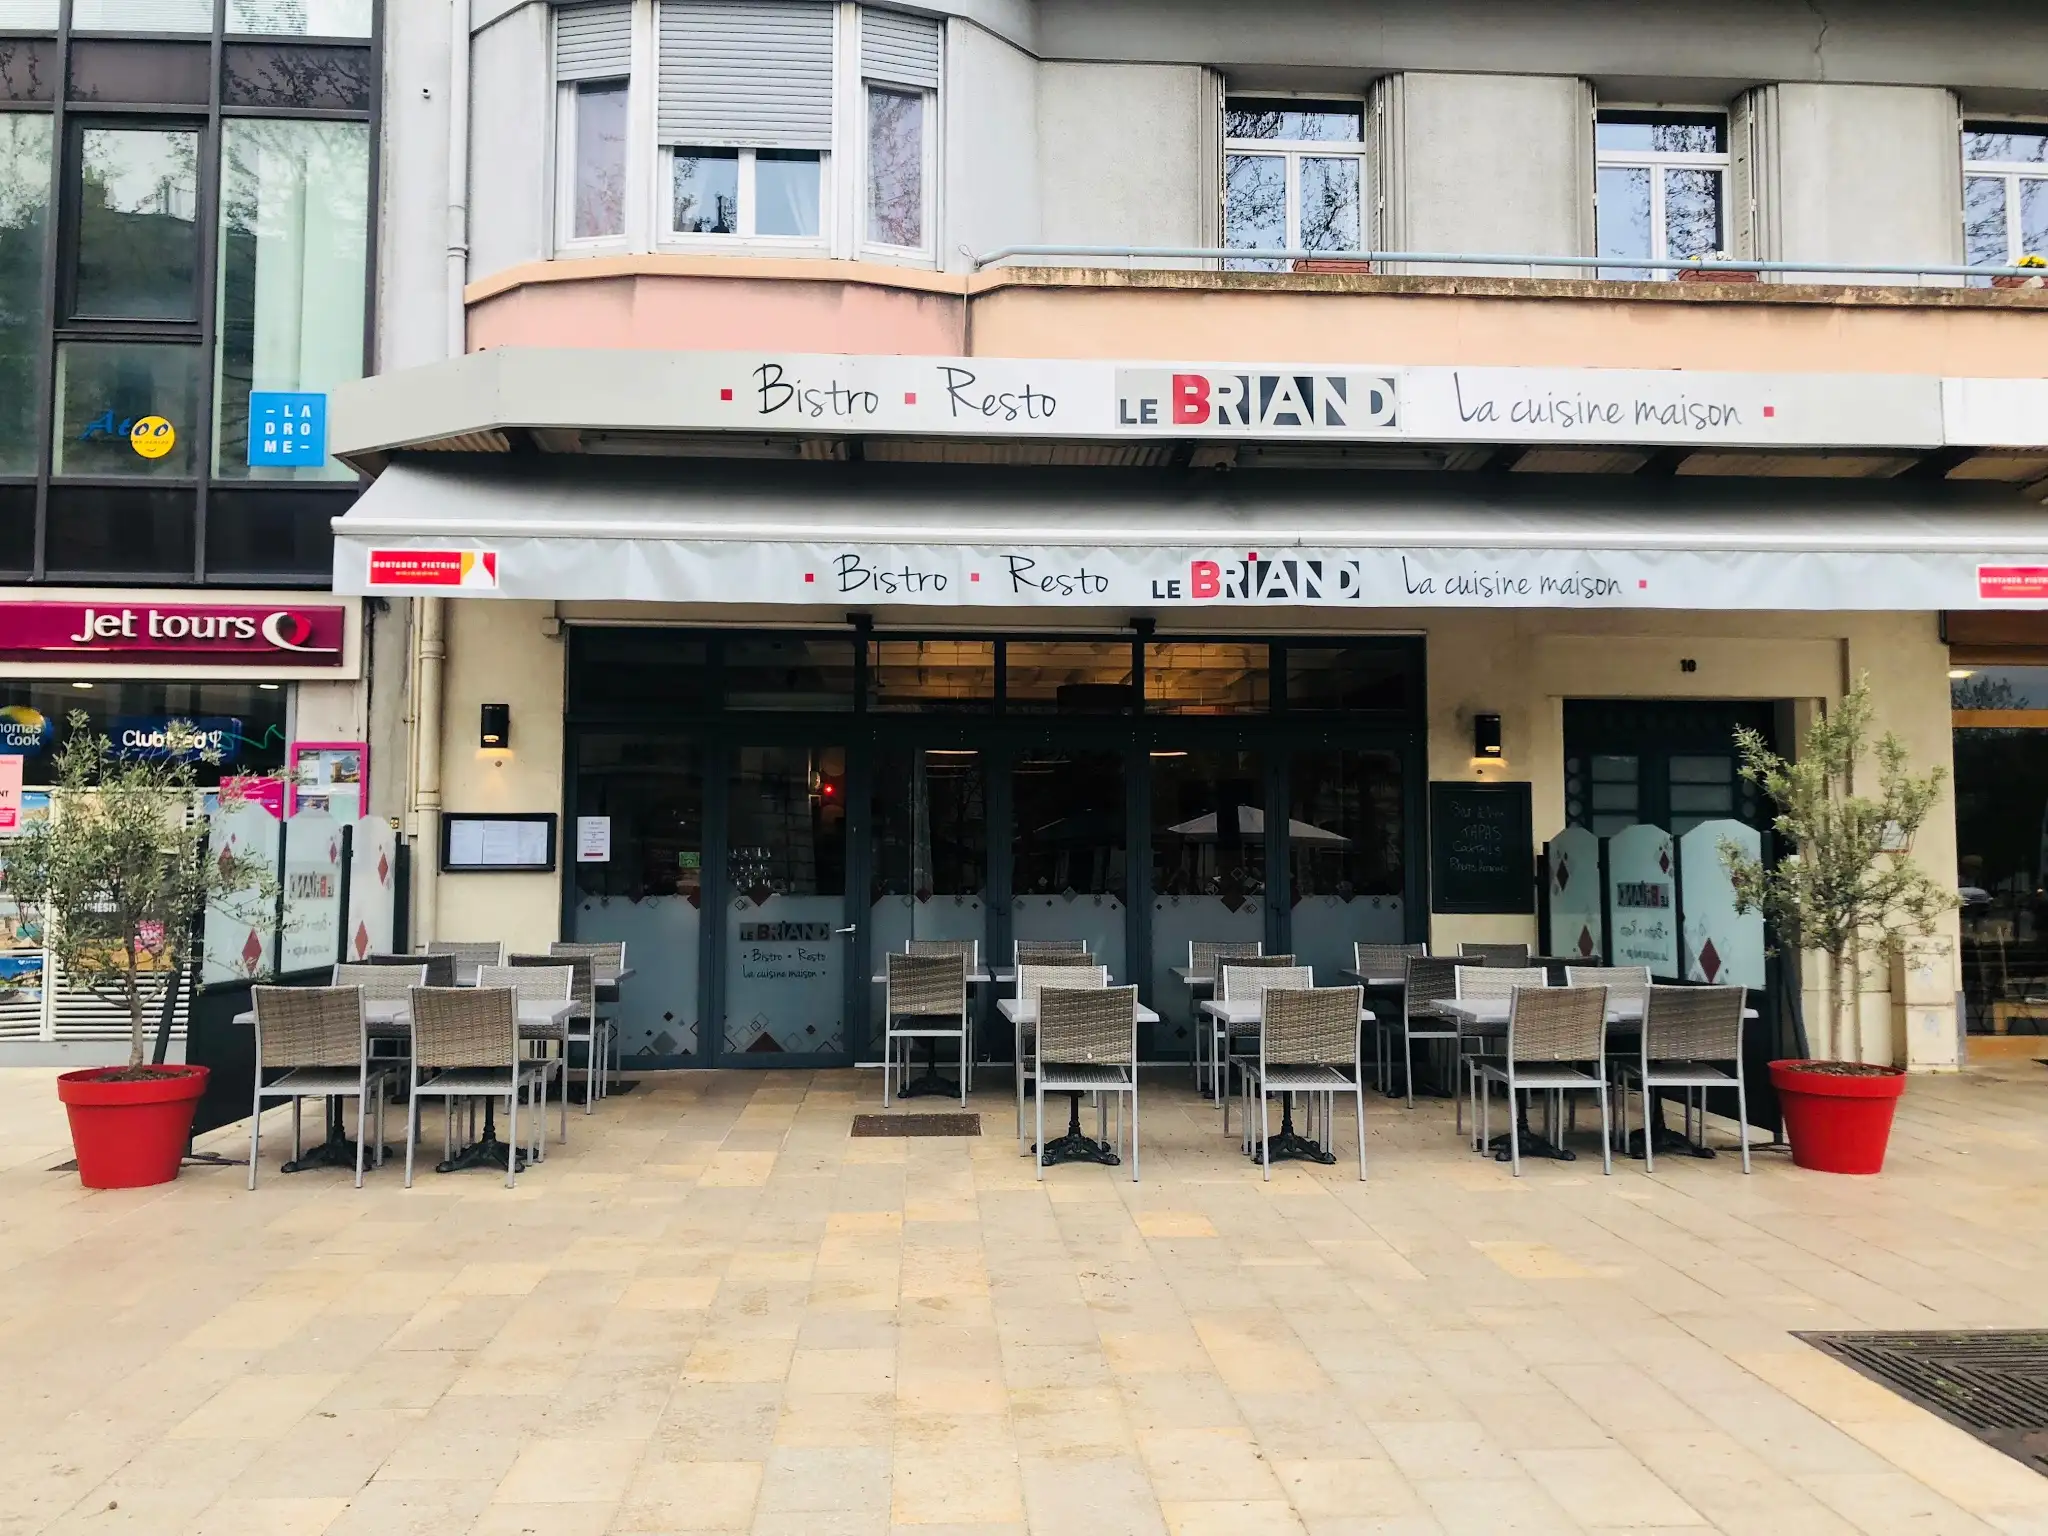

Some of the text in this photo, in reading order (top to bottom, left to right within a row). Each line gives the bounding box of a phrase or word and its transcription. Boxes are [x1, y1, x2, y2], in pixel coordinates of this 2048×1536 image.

[753, 363, 1057, 421] Bistro Resto
[1120, 374, 1397, 427] LE BRIAND
[1453, 371, 1743, 430] La cuisine maison
[832, 554, 1109, 596] Bistro Resto
[1402, 555, 1623, 599] La cuisine maison
[1152, 580, 1181, 599] LE
[70, 608, 257, 642] Jet tours
[1680, 659, 1697, 672] 10
[6, 732, 41, 746] Cook
[122, 729, 164, 748] Club
[1461, 823, 1503, 841] TAPAS
[741, 921, 830, 941] LE BRIAND
[752, 948, 827, 962] Bistro Resto
[788, 969, 817, 980] maison
